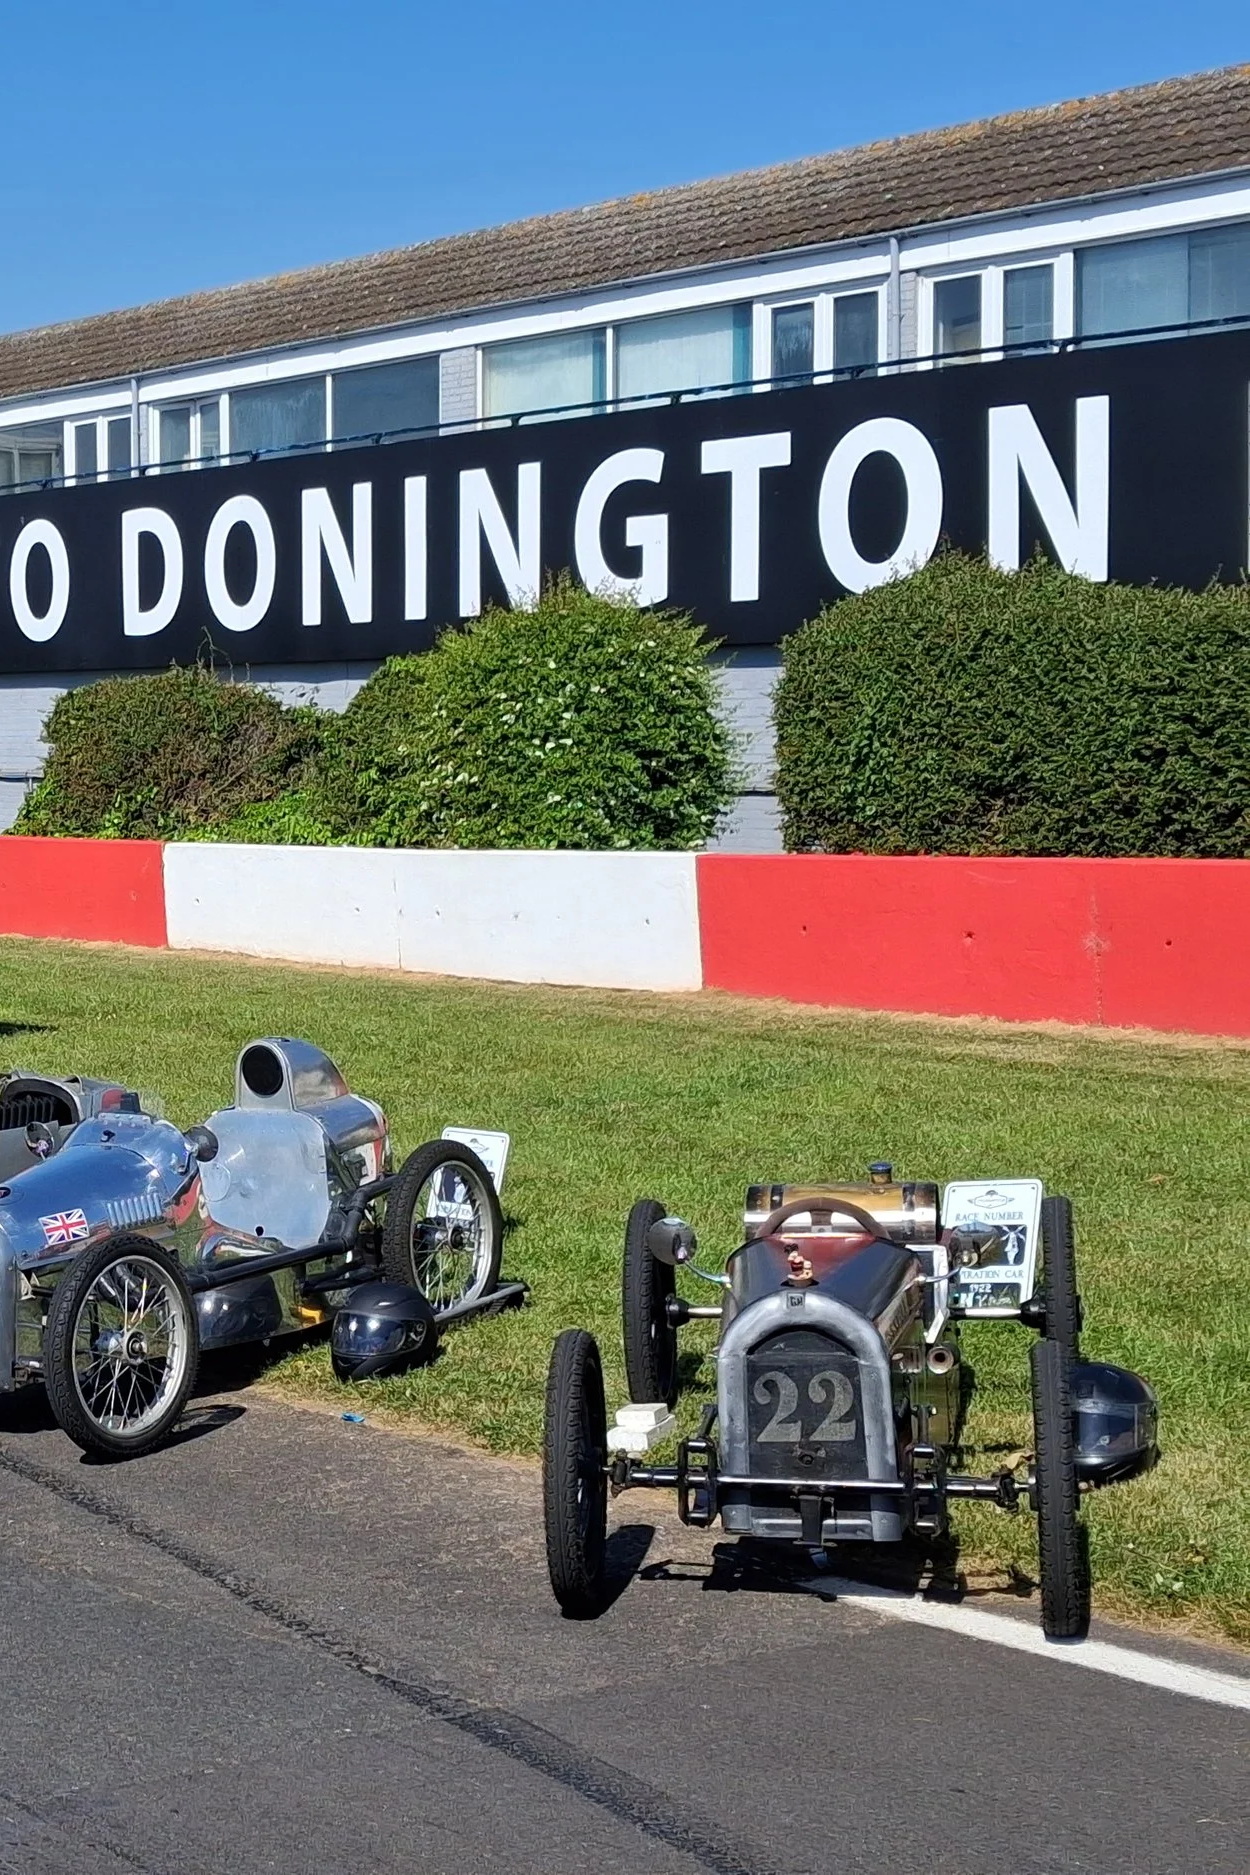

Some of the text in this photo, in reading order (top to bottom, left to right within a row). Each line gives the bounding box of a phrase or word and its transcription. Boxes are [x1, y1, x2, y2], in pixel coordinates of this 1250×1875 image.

[121, 395, 1110, 636] DONINGTON
[955, 1211, 1024, 1223] RACE NUMBER
[1004, 1269, 1025, 1279] CAR
[753, 1371, 856, 1442] 22
